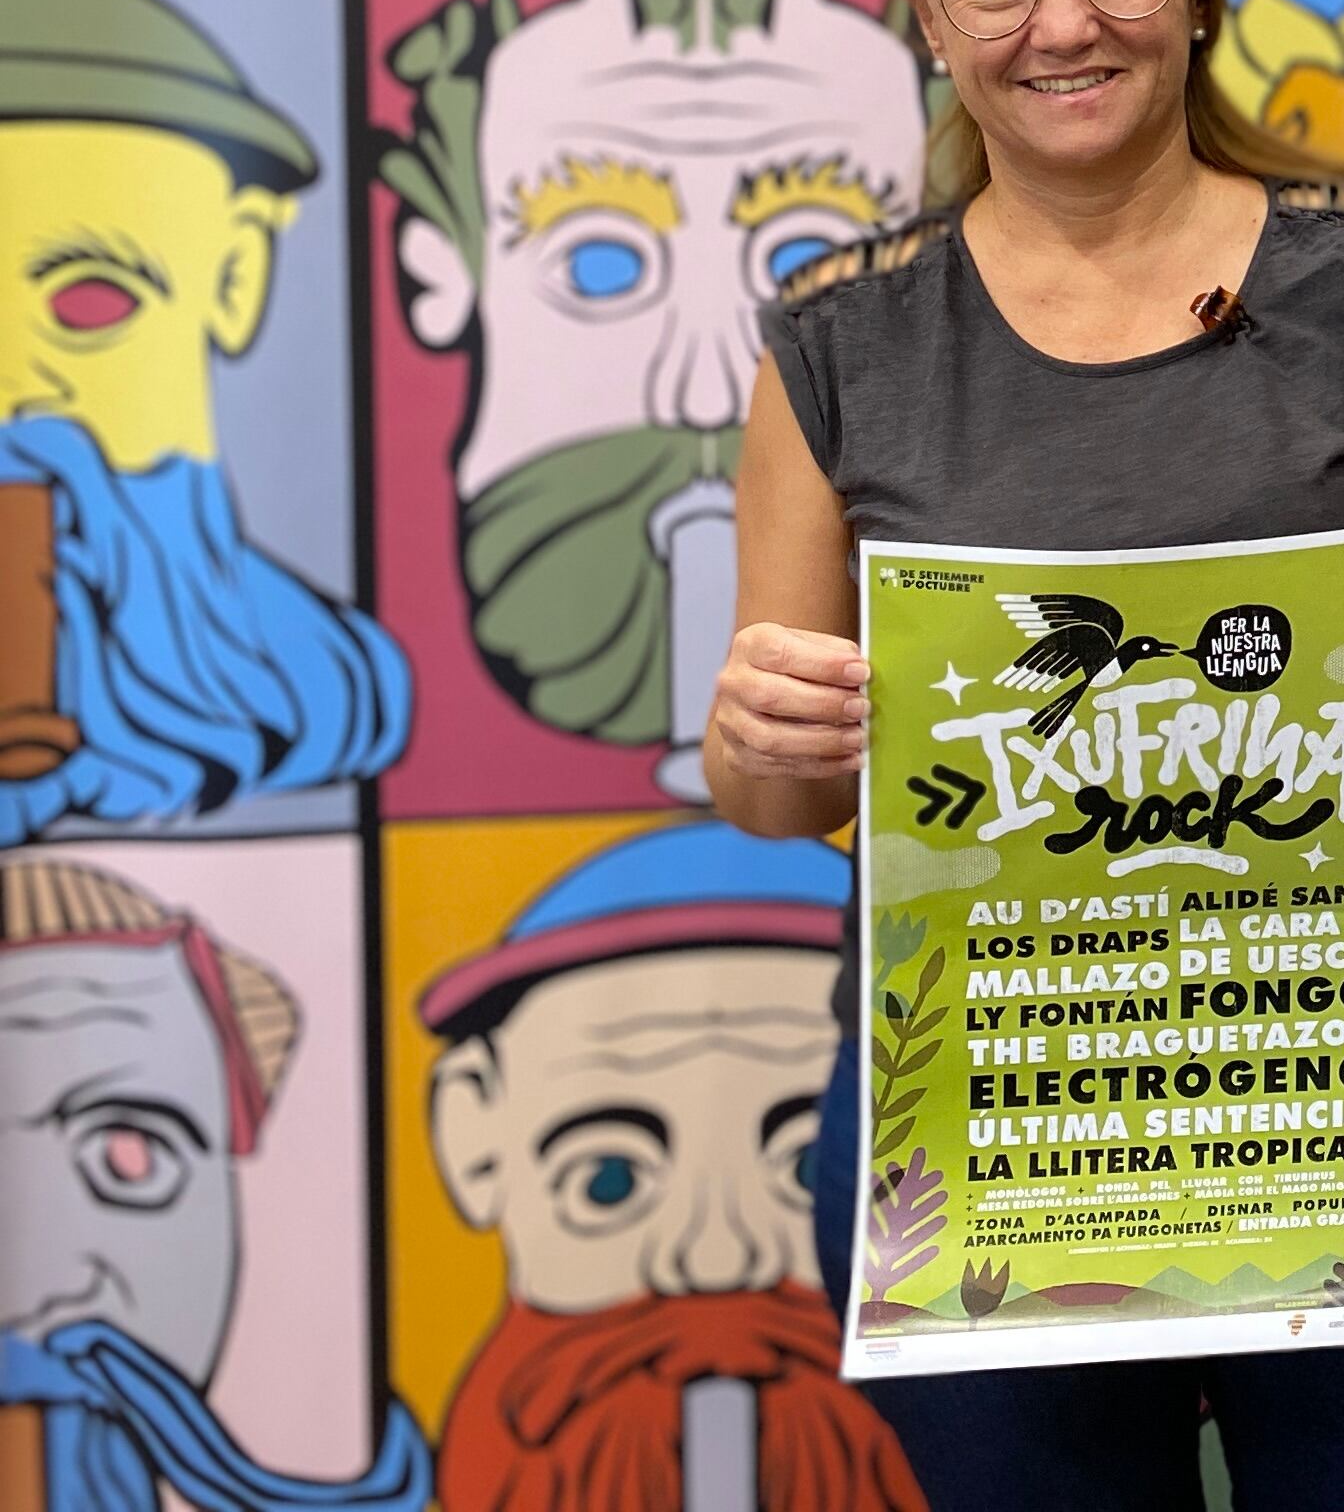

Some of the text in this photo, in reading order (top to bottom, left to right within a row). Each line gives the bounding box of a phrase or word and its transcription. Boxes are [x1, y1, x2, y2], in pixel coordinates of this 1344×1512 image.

[900, 569, 985, 584] DE SETIEMBRE
[903, 580, 971, 592] D'OCTUBRE
[1221, 615, 1270, 635] PER LA
[1211, 632, 1281, 655] NUESTRA
[1206, 651, 1282, 677] LLENGUA
[968, 887, 1168, 925] AU D'ASTÍ
[1180, 882, 1277, 912] ALIDÉ
[1180, 917, 1226, 942] LA
[1240, 911, 1340, 939] CARA
[968, 929, 1169, 960] LOS DRAPS
[1180, 948, 1230, 976] DE
[966, 962, 1170, 999] MALLAZO
[967, 992, 1167, 1031] LY FONTÁN
[968, 1036, 1046, 1066] THE
[969, 1108, 1129, 1147] ÚLTIMA
[968, 1154, 1013, 1181] LA
[1029, 1145, 1177, 1177] LLITERA
[1045, 1208, 1160, 1227] D'ACAMPADA
[1208, 1202, 1273, 1217] DISNAR
[964, 1229, 1085, 1248] APARCAMENTO
[1092, 1227, 1112, 1240] PA
[1117, 1221, 1221, 1239] FURGONETAS
[1238, 1216, 1312, 1232] ENTRADA
